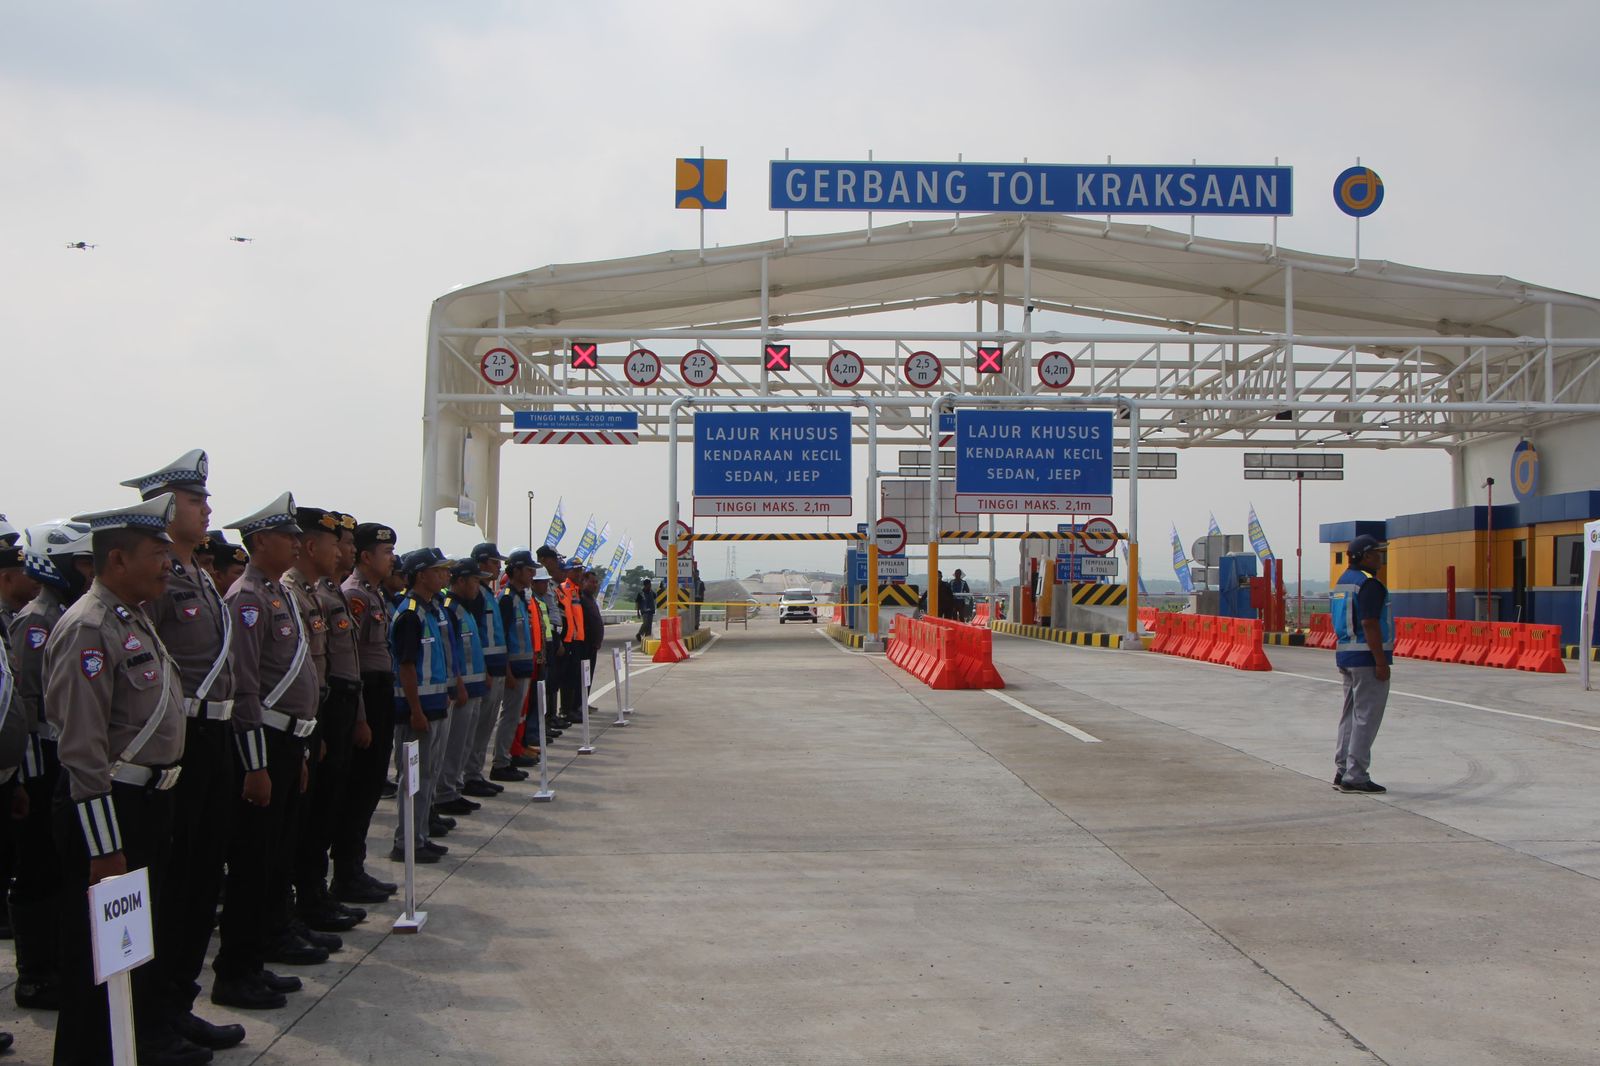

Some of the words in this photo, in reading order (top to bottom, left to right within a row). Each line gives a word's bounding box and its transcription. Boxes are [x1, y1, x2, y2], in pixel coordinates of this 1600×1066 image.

[786, 168, 967, 204] GERBANG
[987, 171, 1054, 206] TOL
[1077, 173, 1278, 208] KRAKSAAN
[492, 355, 507, 366] 2,5
[692, 356, 706, 368] 2,5
[916, 358, 930, 369] 2,5
[494, 368, 504, 377] m
[631, 363, 655, 374] 4,2m
[694, 369, 704, 378] m
[834, 364, 857, 375] 4,2m
[1044, 365, 1068, 375] 4,2m
[918, 371, 927, 380] m
[706, 427, 760, 441] LAJUR
[770, 427, 838, 441] KHUSUS
[968, 425, 1021, 439] LAJUR
[1031, 426, 1101, 440] KHUSUS
[704, 450, 793, 461] KENDARAAN
[802, 450, 842, 461] KECIL
[966, 447, 1055, 460] KENDARAAN
[1063, 448, 1103, 460] KECIL
[725, 471, 778, 484] SEDAN,
[785, 471, 820, 482] JEEP
[987, 468, 1040, 481] SEDAN,
[1047, 469, 1082, 480] JEEP
[715, 502, 756, 512] TINGGI
[762, 502, 798, 512] MAKS.
[804, 502, 831, 514] 2,1m
[978, 499, 1018, 510] TINGGI
[1024, 500, 1060, 511] MAKS.
[1065, 500, 1091, 512] 2,1m
[104, 890, 143, 922] KODIM
